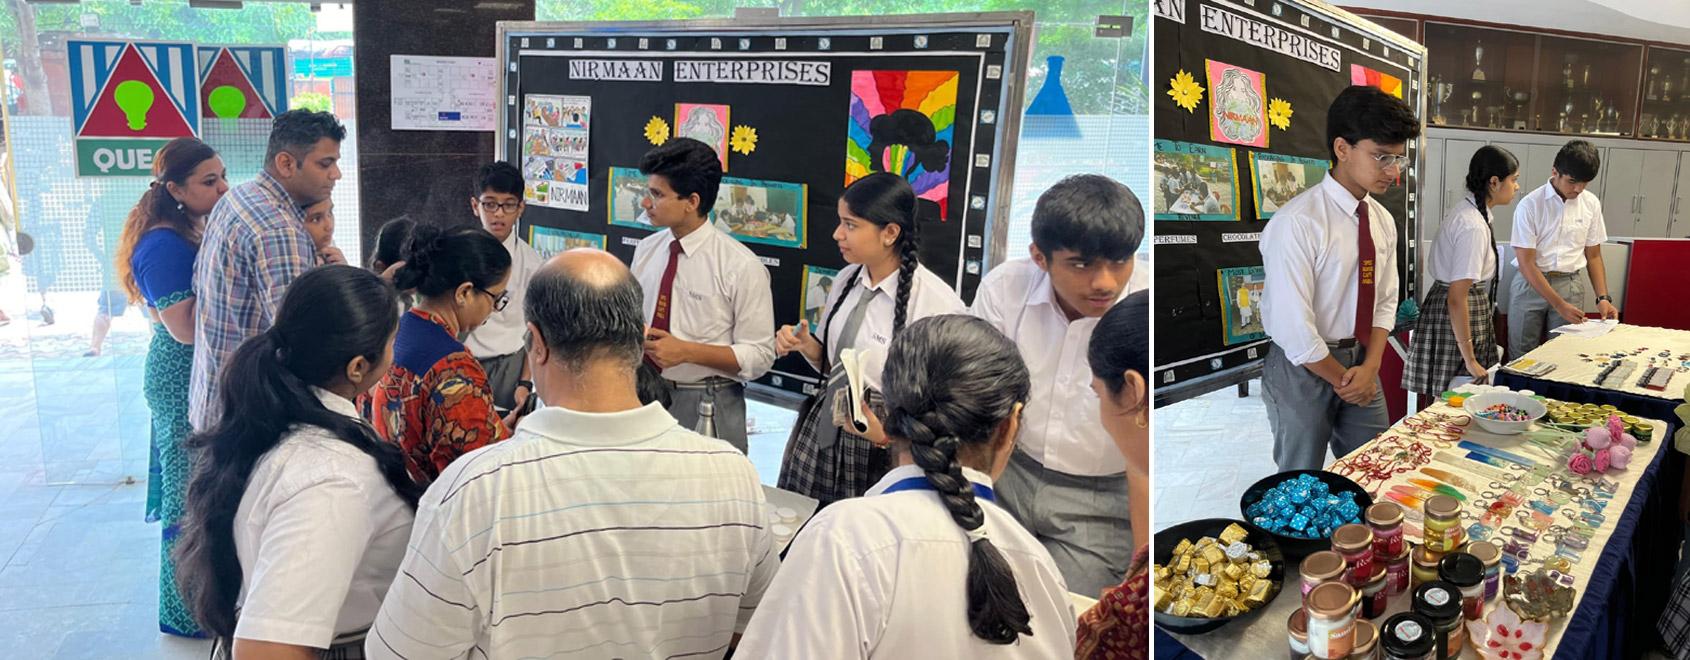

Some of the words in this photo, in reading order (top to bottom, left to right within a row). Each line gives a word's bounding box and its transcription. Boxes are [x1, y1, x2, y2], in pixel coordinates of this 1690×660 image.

[1202, 8, 1340, 71] ENTERPRISES
[570, 61, 661, 80] NIRMAAN
[676, 61, 829, 83] ENTERPRISES
